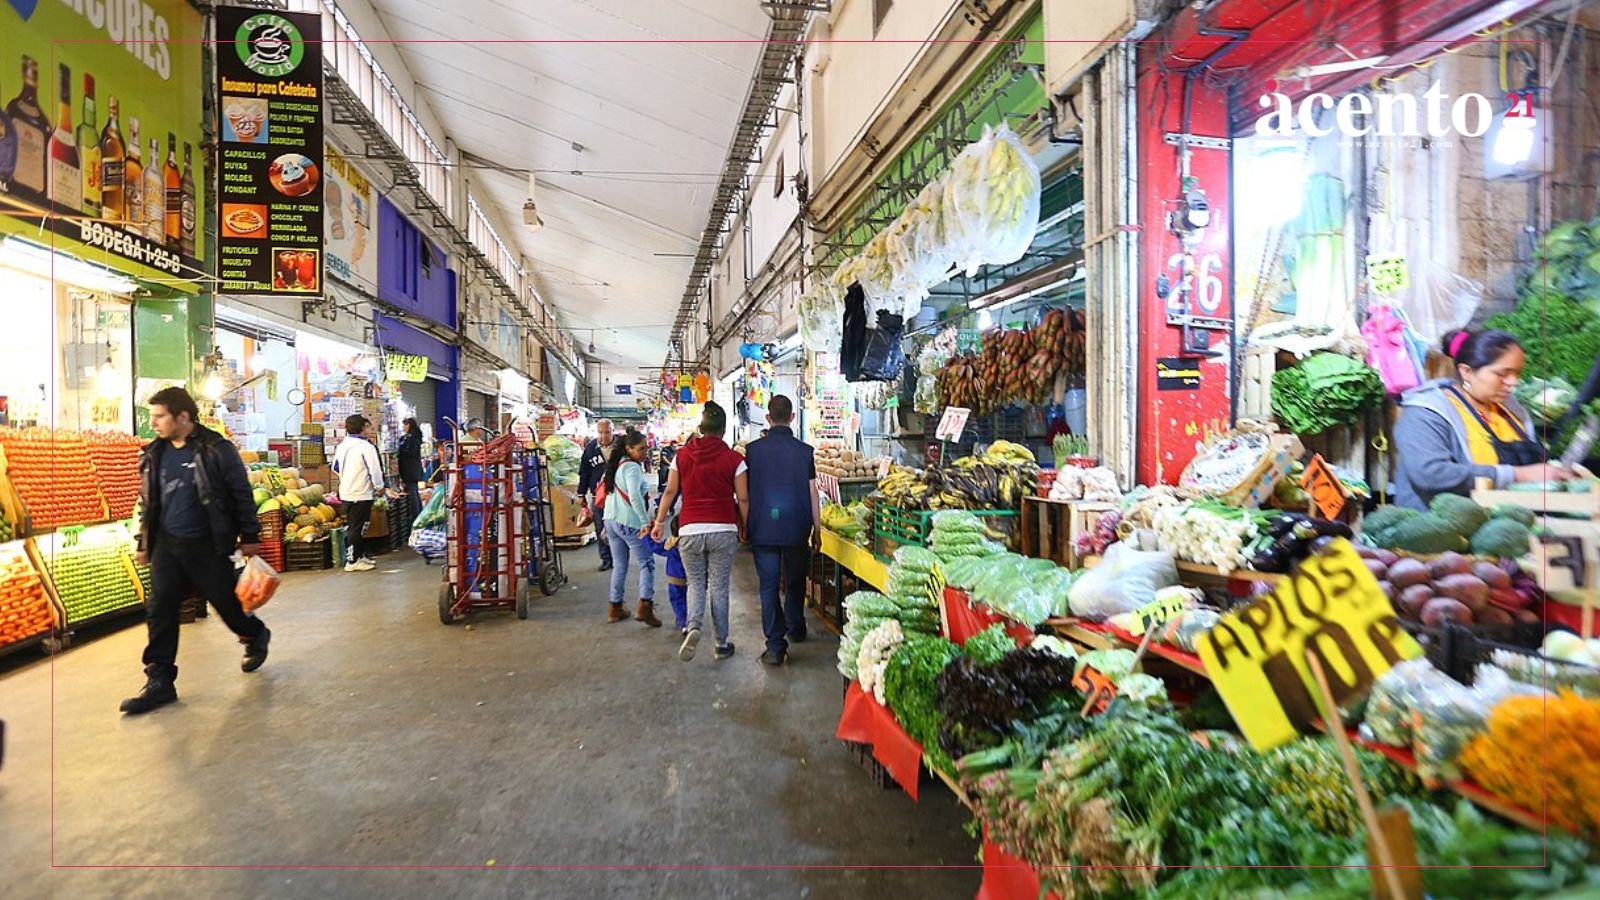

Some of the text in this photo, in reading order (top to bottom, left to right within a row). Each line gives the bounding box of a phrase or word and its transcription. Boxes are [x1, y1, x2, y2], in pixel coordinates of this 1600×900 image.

[222, 77, 256, 93] Insumos
[257, 83, 277, 96] para
[224, 150, 267, 159] CAPACILLOS
[224, 162, 248, 170] DUYAS
[224, 174, 253, 182] MOLDES
[224, 186, 257, 194] FONDANT
[271, 213, 303, 221] CHOCOLATE
[81, 219, 142, 260] BODEGA
[1167, 253, 1222, 314] 26
[1208, 549, 1356, 671] APIOS
